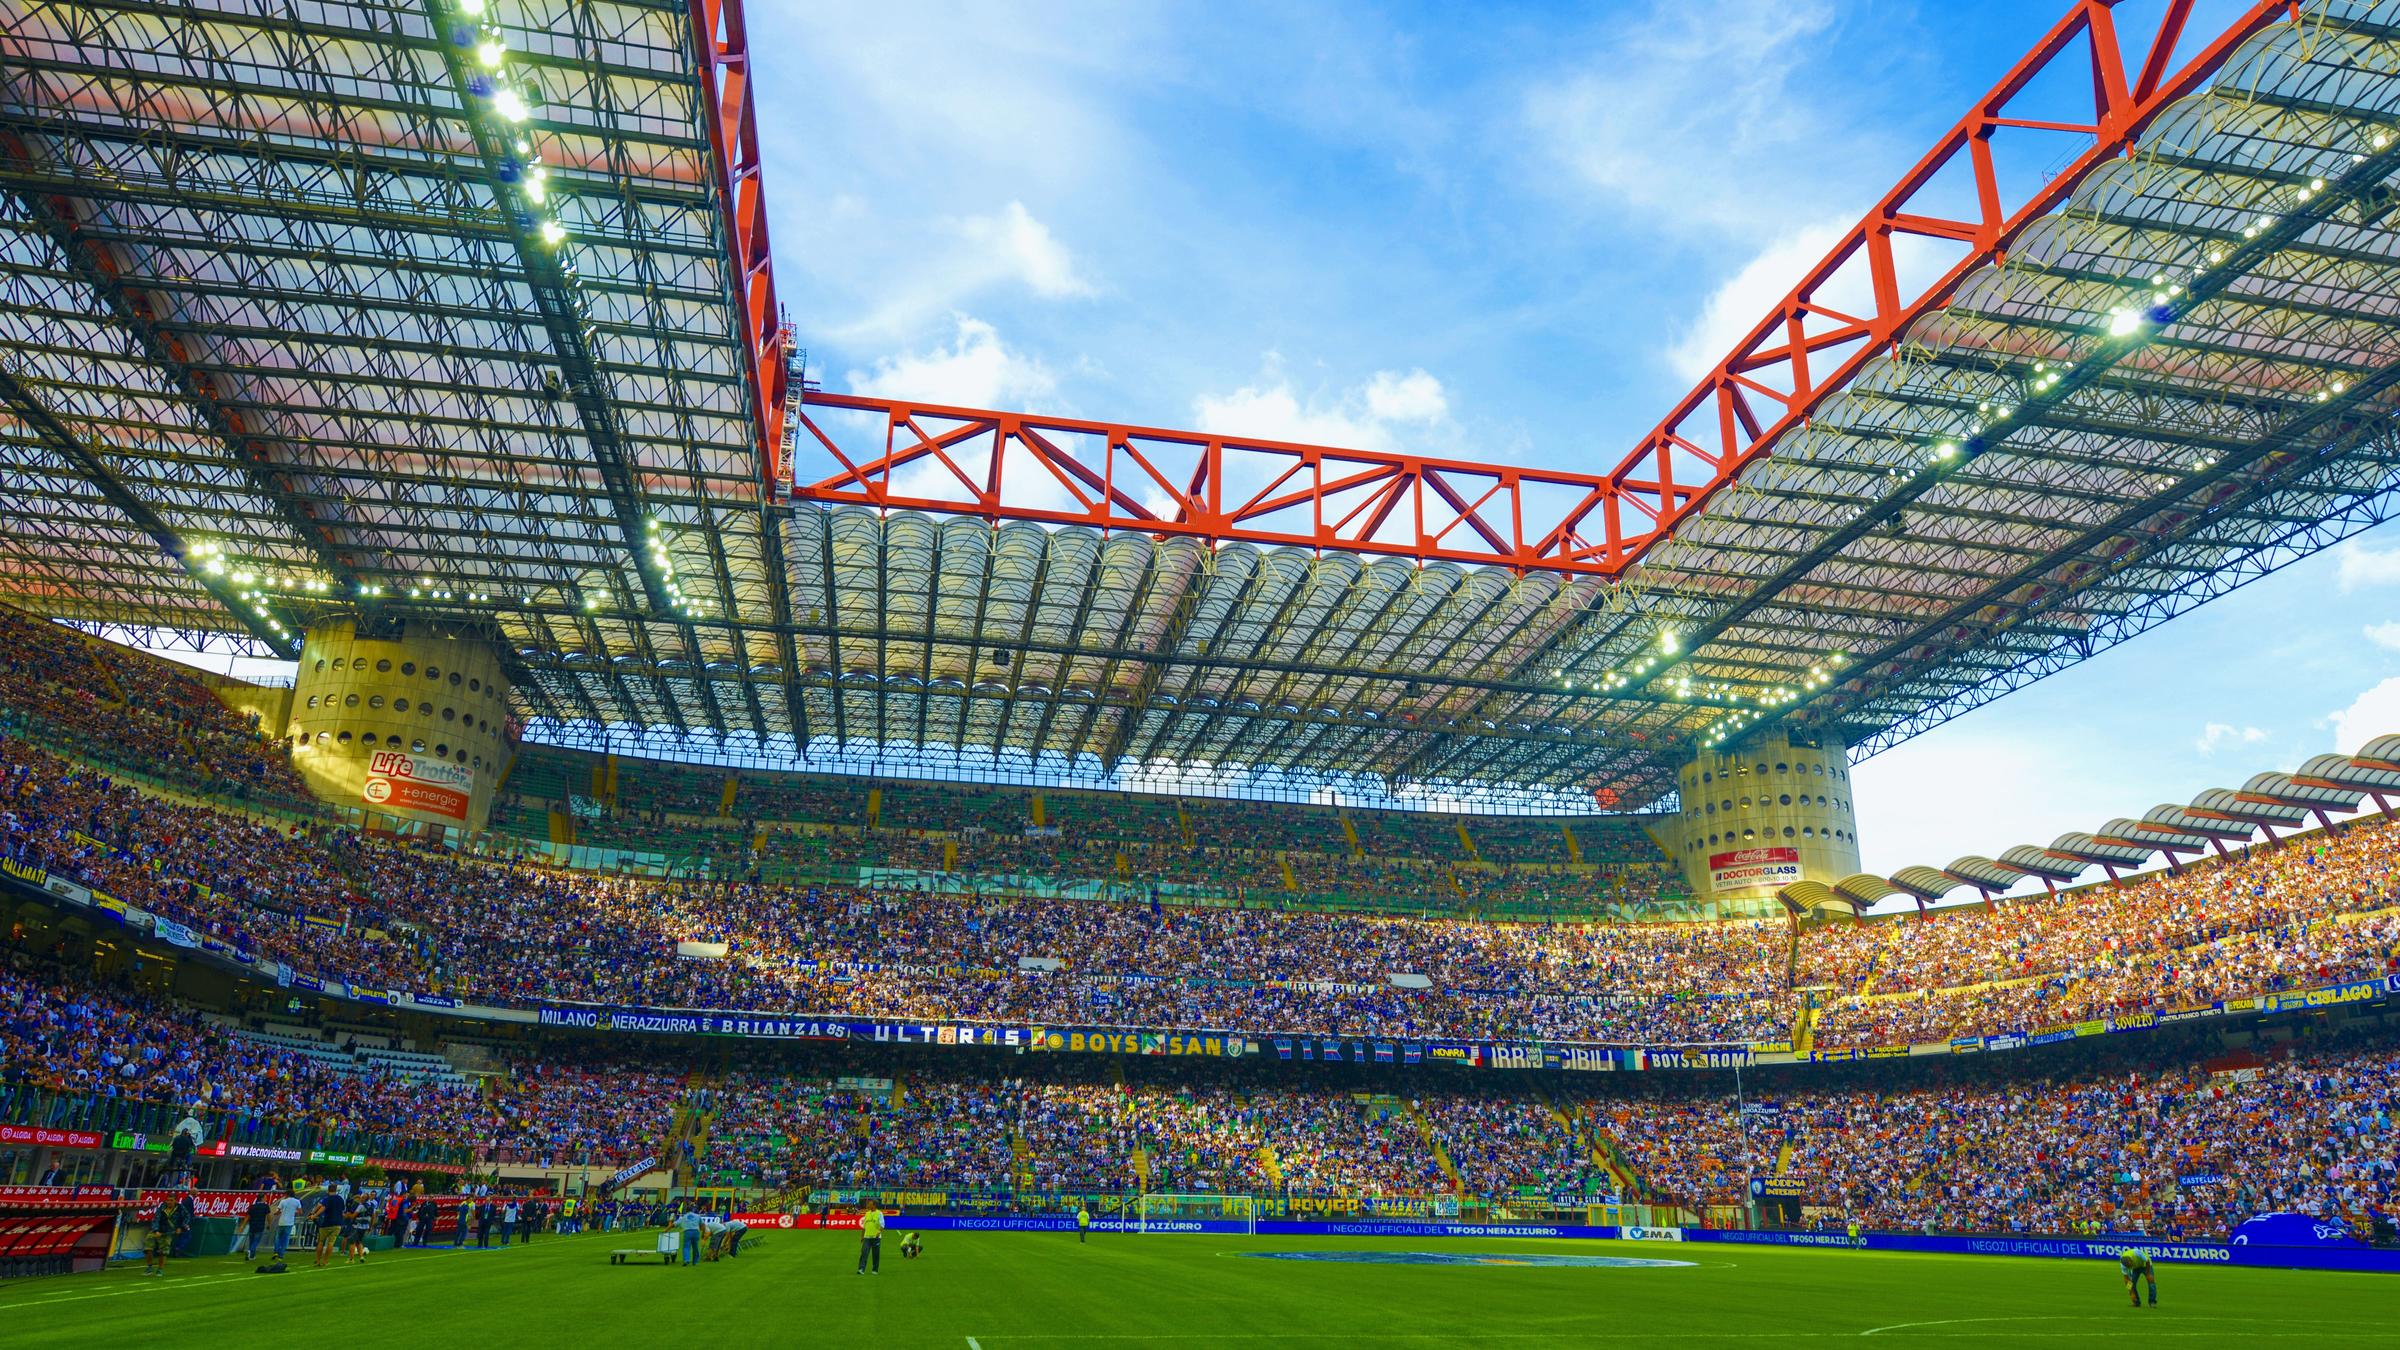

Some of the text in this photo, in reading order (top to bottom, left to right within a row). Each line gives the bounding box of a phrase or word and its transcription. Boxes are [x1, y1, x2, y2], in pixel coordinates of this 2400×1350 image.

[2, 856, 47, 884] GALLARATE
[1723, 866, 1797, 880] DOCTORGLASS
[1734, 878, 1752, 886] AUTO
[2306, 984, 2373, 1005] CISLAGO
[540, 1010, 697, 1032] MILANO NERAZZURRA
[2115, 1013, 2152, 1030] SOVIZZO
[721, 1019, 845, 1038] BRIANZA 85
[1070, 1033, 1222, 1057] BOYS SAN
[1432, 1047, 1466, 1058] NOVARA
[1652, 1053, 1755, 1068] BOYS ROMA
[13, 1131, 31, 1140] ALGIDA
[46, 1134, 64, 1142] ALGIDA
[78, 1136, 96, 1144] ALGIDA
[230, 1144, 302, 1161] www.tecnovision.com
[1764, 1179, 1806, 1187] MODENA
[209, 1196, 229, 1215] Lete
[230, 1197, 250, 1216] Lete
[958, 1220, 1000, 1228] NEGOZI
[1003, 1220, 1054, 1229] UFFICIALI
[1057, 1221, 1078, 1229] DEL
[1088, 1222, 1122, 1230] IFOSO
[1125, 1222, 1202, 1230] NERAZZURRO
[1333, 1225, 1371, 1233] NEGOZI
[1374, 1225, 1421, 1234] UFFICIALI
[1424, 1226, 1444, 1234] DEL
[1446, 1226, 1484, 1235] TIFOSO
[1486, 1227, 1557, 1236] NERAZZURRO
[1631, 1228, 1674, 1239] VEMA
[1722, 1233, 1745, 1241] NEGOZI
[1746, 1233, 1775, 1242] UFFICIALI
[1775, 1235, 1788, 1243] DEL
[1789, 1235, 1814, 1244] TIFOSO
[1973, 1241, 2009, 1252] NEGOZI
[2011, 1242, 2060, 1254] UFFICIALI
[2063, 1244, 2083, 1255] DEL
